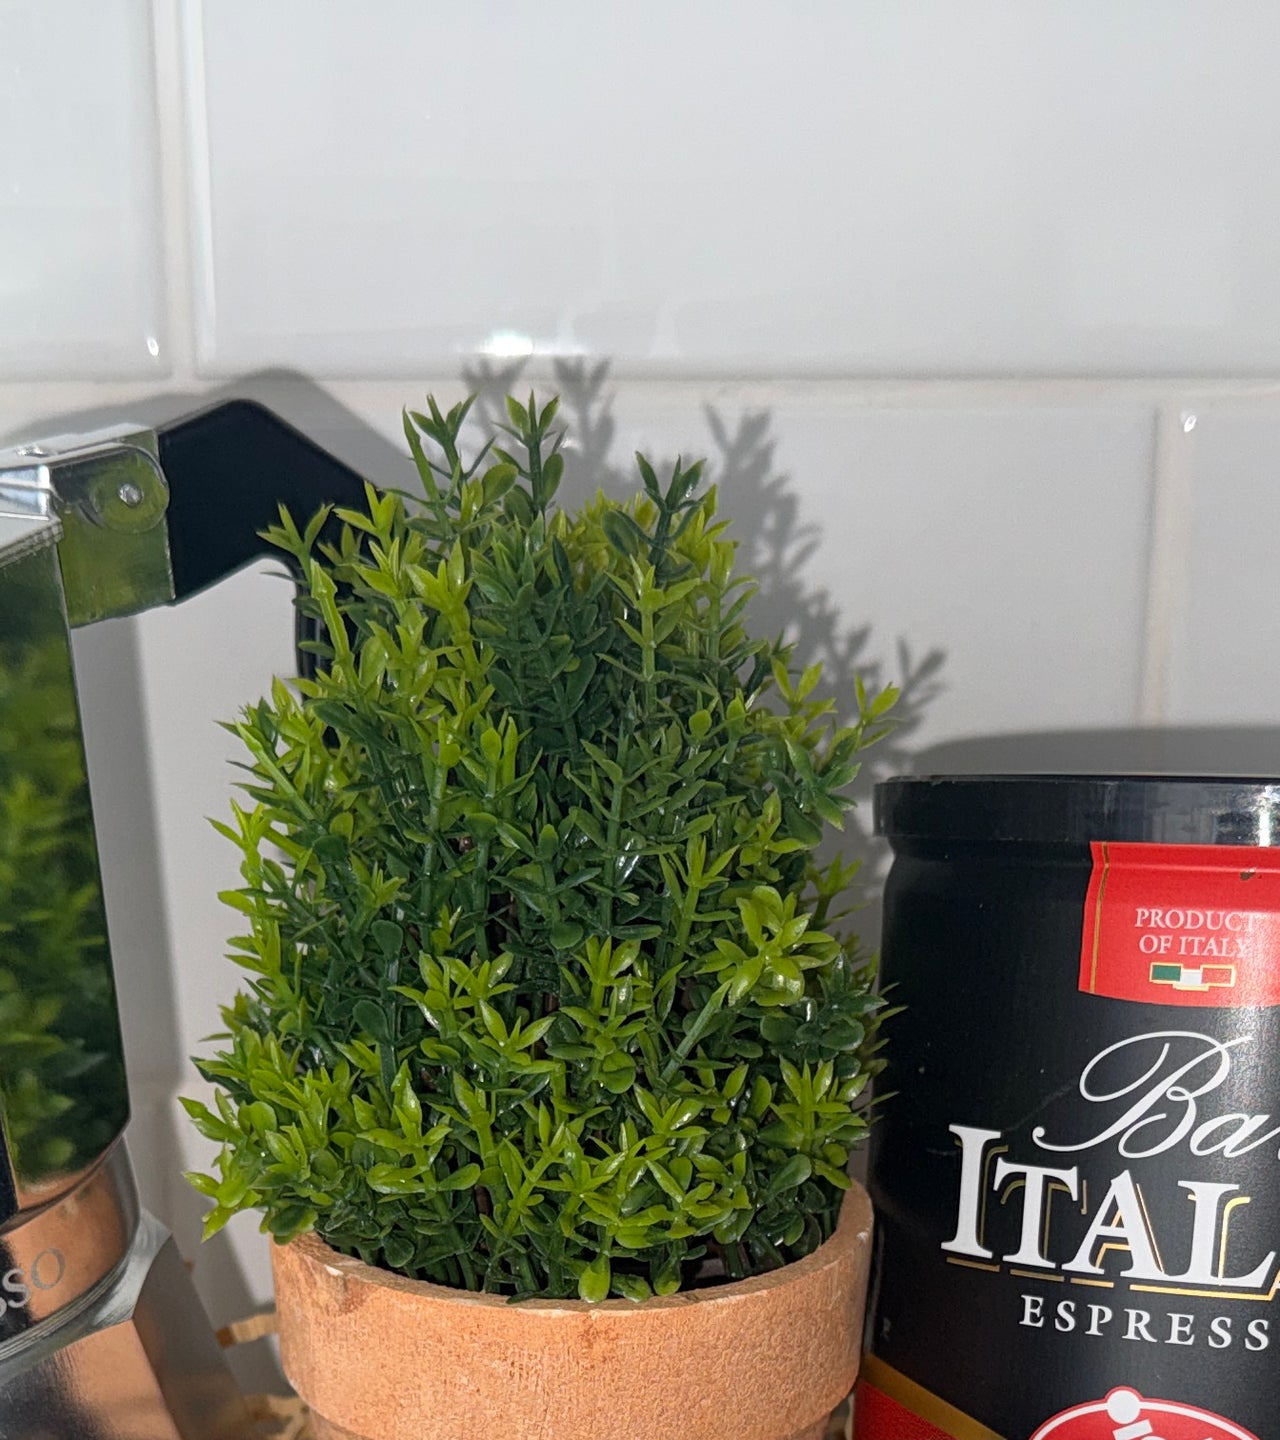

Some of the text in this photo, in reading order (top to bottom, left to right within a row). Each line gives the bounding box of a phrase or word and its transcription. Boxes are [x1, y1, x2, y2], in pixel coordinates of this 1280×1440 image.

[1133, 907, 1261, 932] PRODUCT
[1138, 934, 1256, 959] OF ITALY
